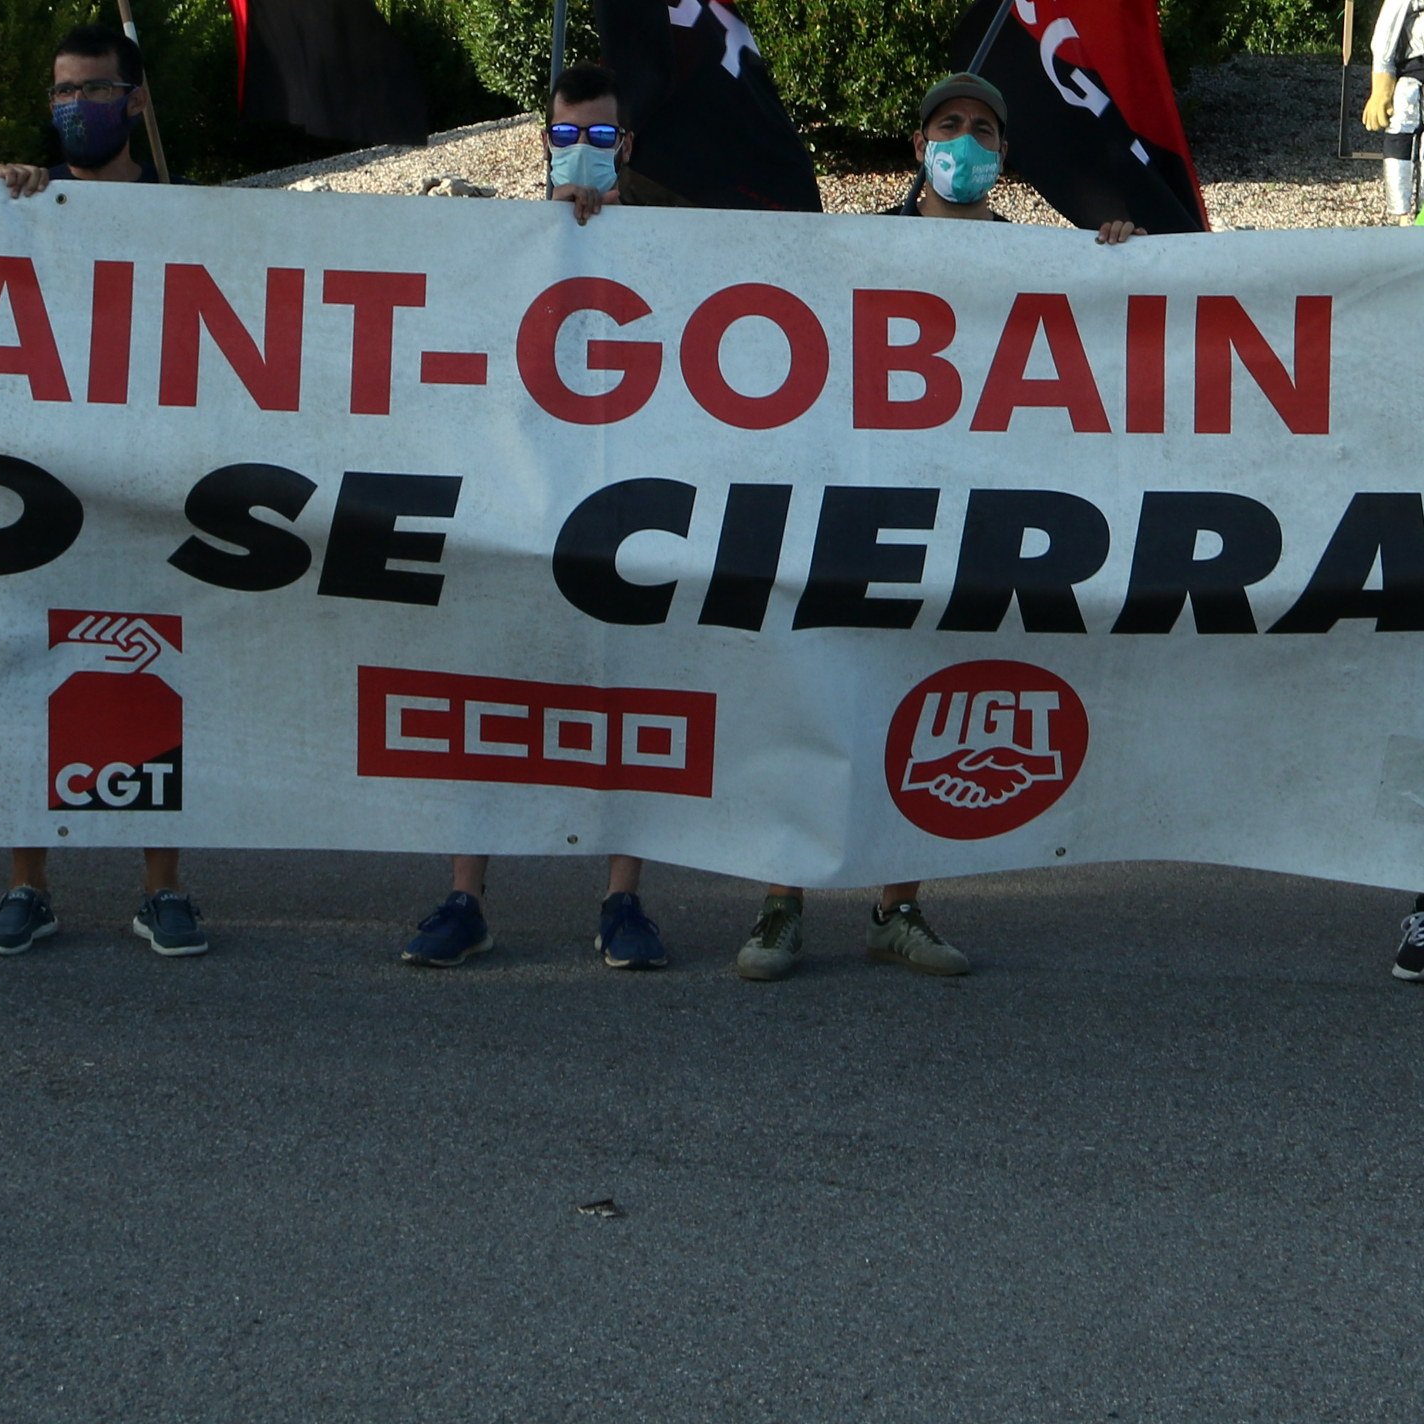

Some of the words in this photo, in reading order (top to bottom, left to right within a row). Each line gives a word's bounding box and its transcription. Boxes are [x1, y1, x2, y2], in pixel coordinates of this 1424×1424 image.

[167, 463, 462, 606] SE
[385, 693, 688, 770] CCOO
[911, 690, 1061, 758] UGT
[55, 762, 173, 806] CGT
